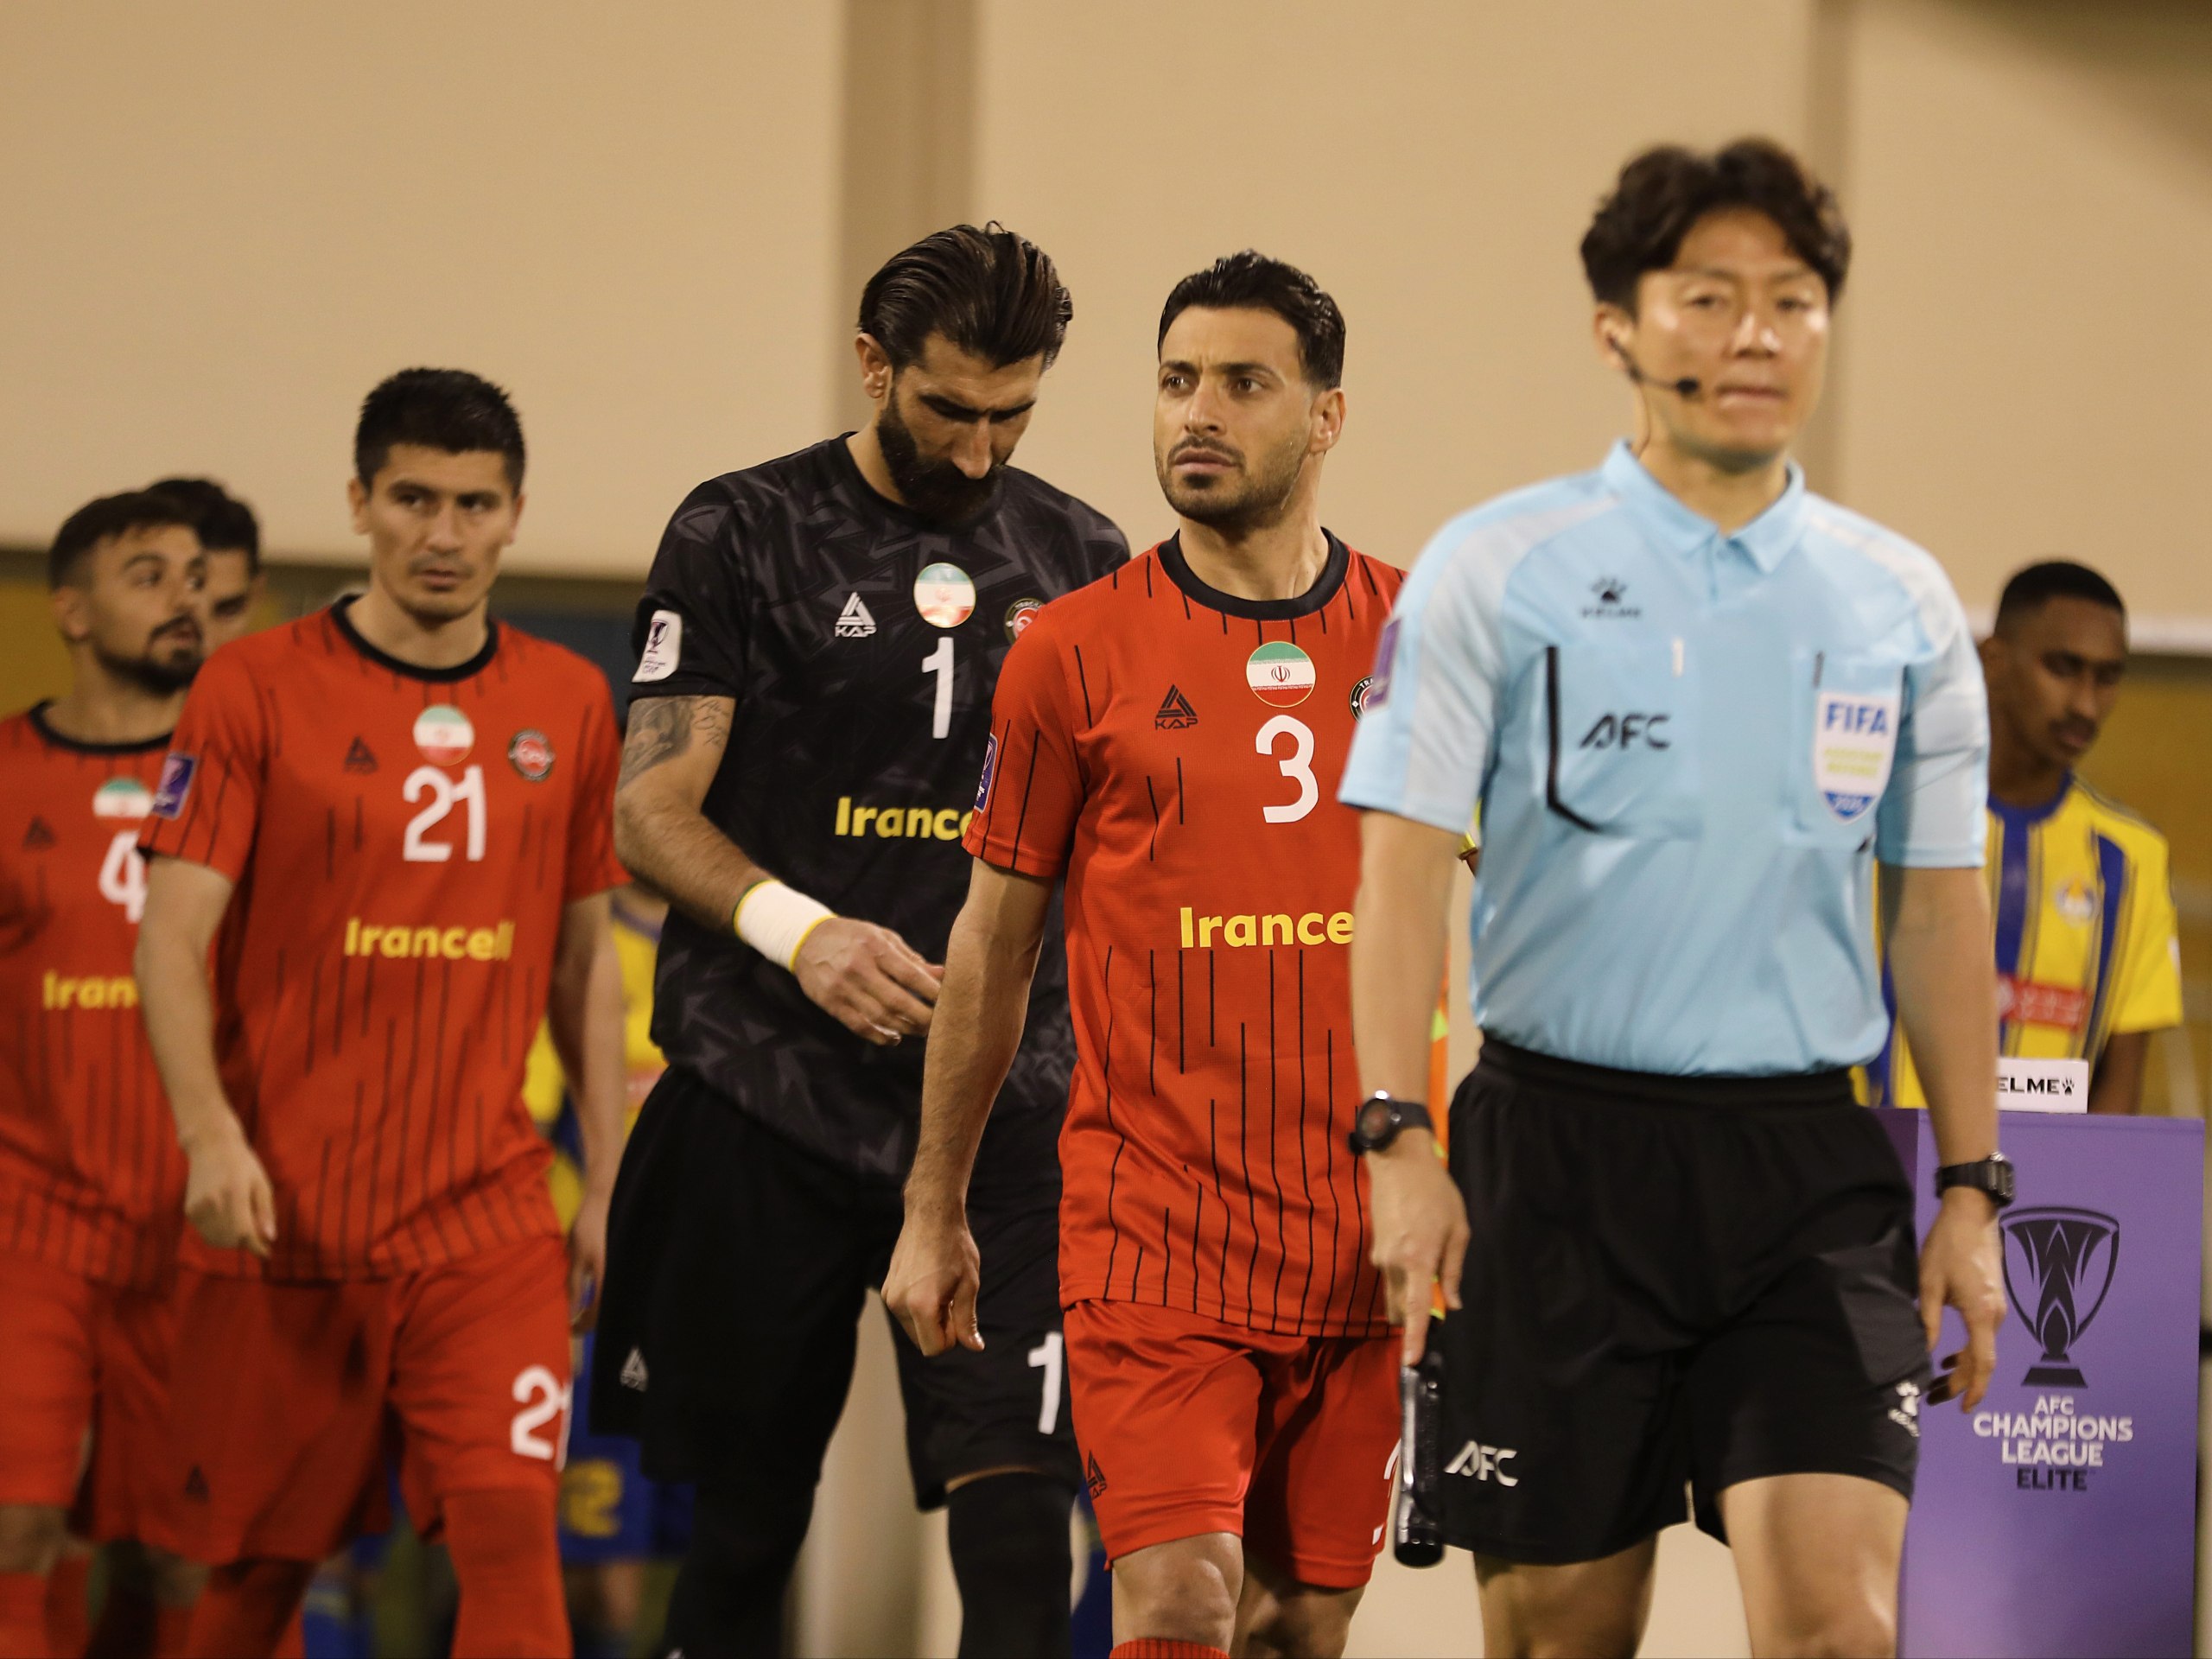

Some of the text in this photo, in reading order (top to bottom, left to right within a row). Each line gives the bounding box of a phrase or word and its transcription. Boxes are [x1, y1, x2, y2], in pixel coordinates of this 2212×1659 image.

[835, 626, 876, 638] KAP
[921, 636, 955, 740] 1
[1154, 717, 1198, 730] KAP
[1580, 712, 1670, 751] AFC
[1825, 702, 1888, 735] FIFA
[1255, 715, 1319, 823] 3
[403, 764, 487, 862] 21
[1027, 1332, 1064, 1435] 1
[2034, 1395, 2074, 1415] AFC
[1973, 1411, 2134, 1442] CHAMPIONS
[1445, 1440, 1519, 1488] AFC
[2001, 1438, 2104, 1467] LEAGUE
[2017, 1467, 2088, 1492] ELITE
